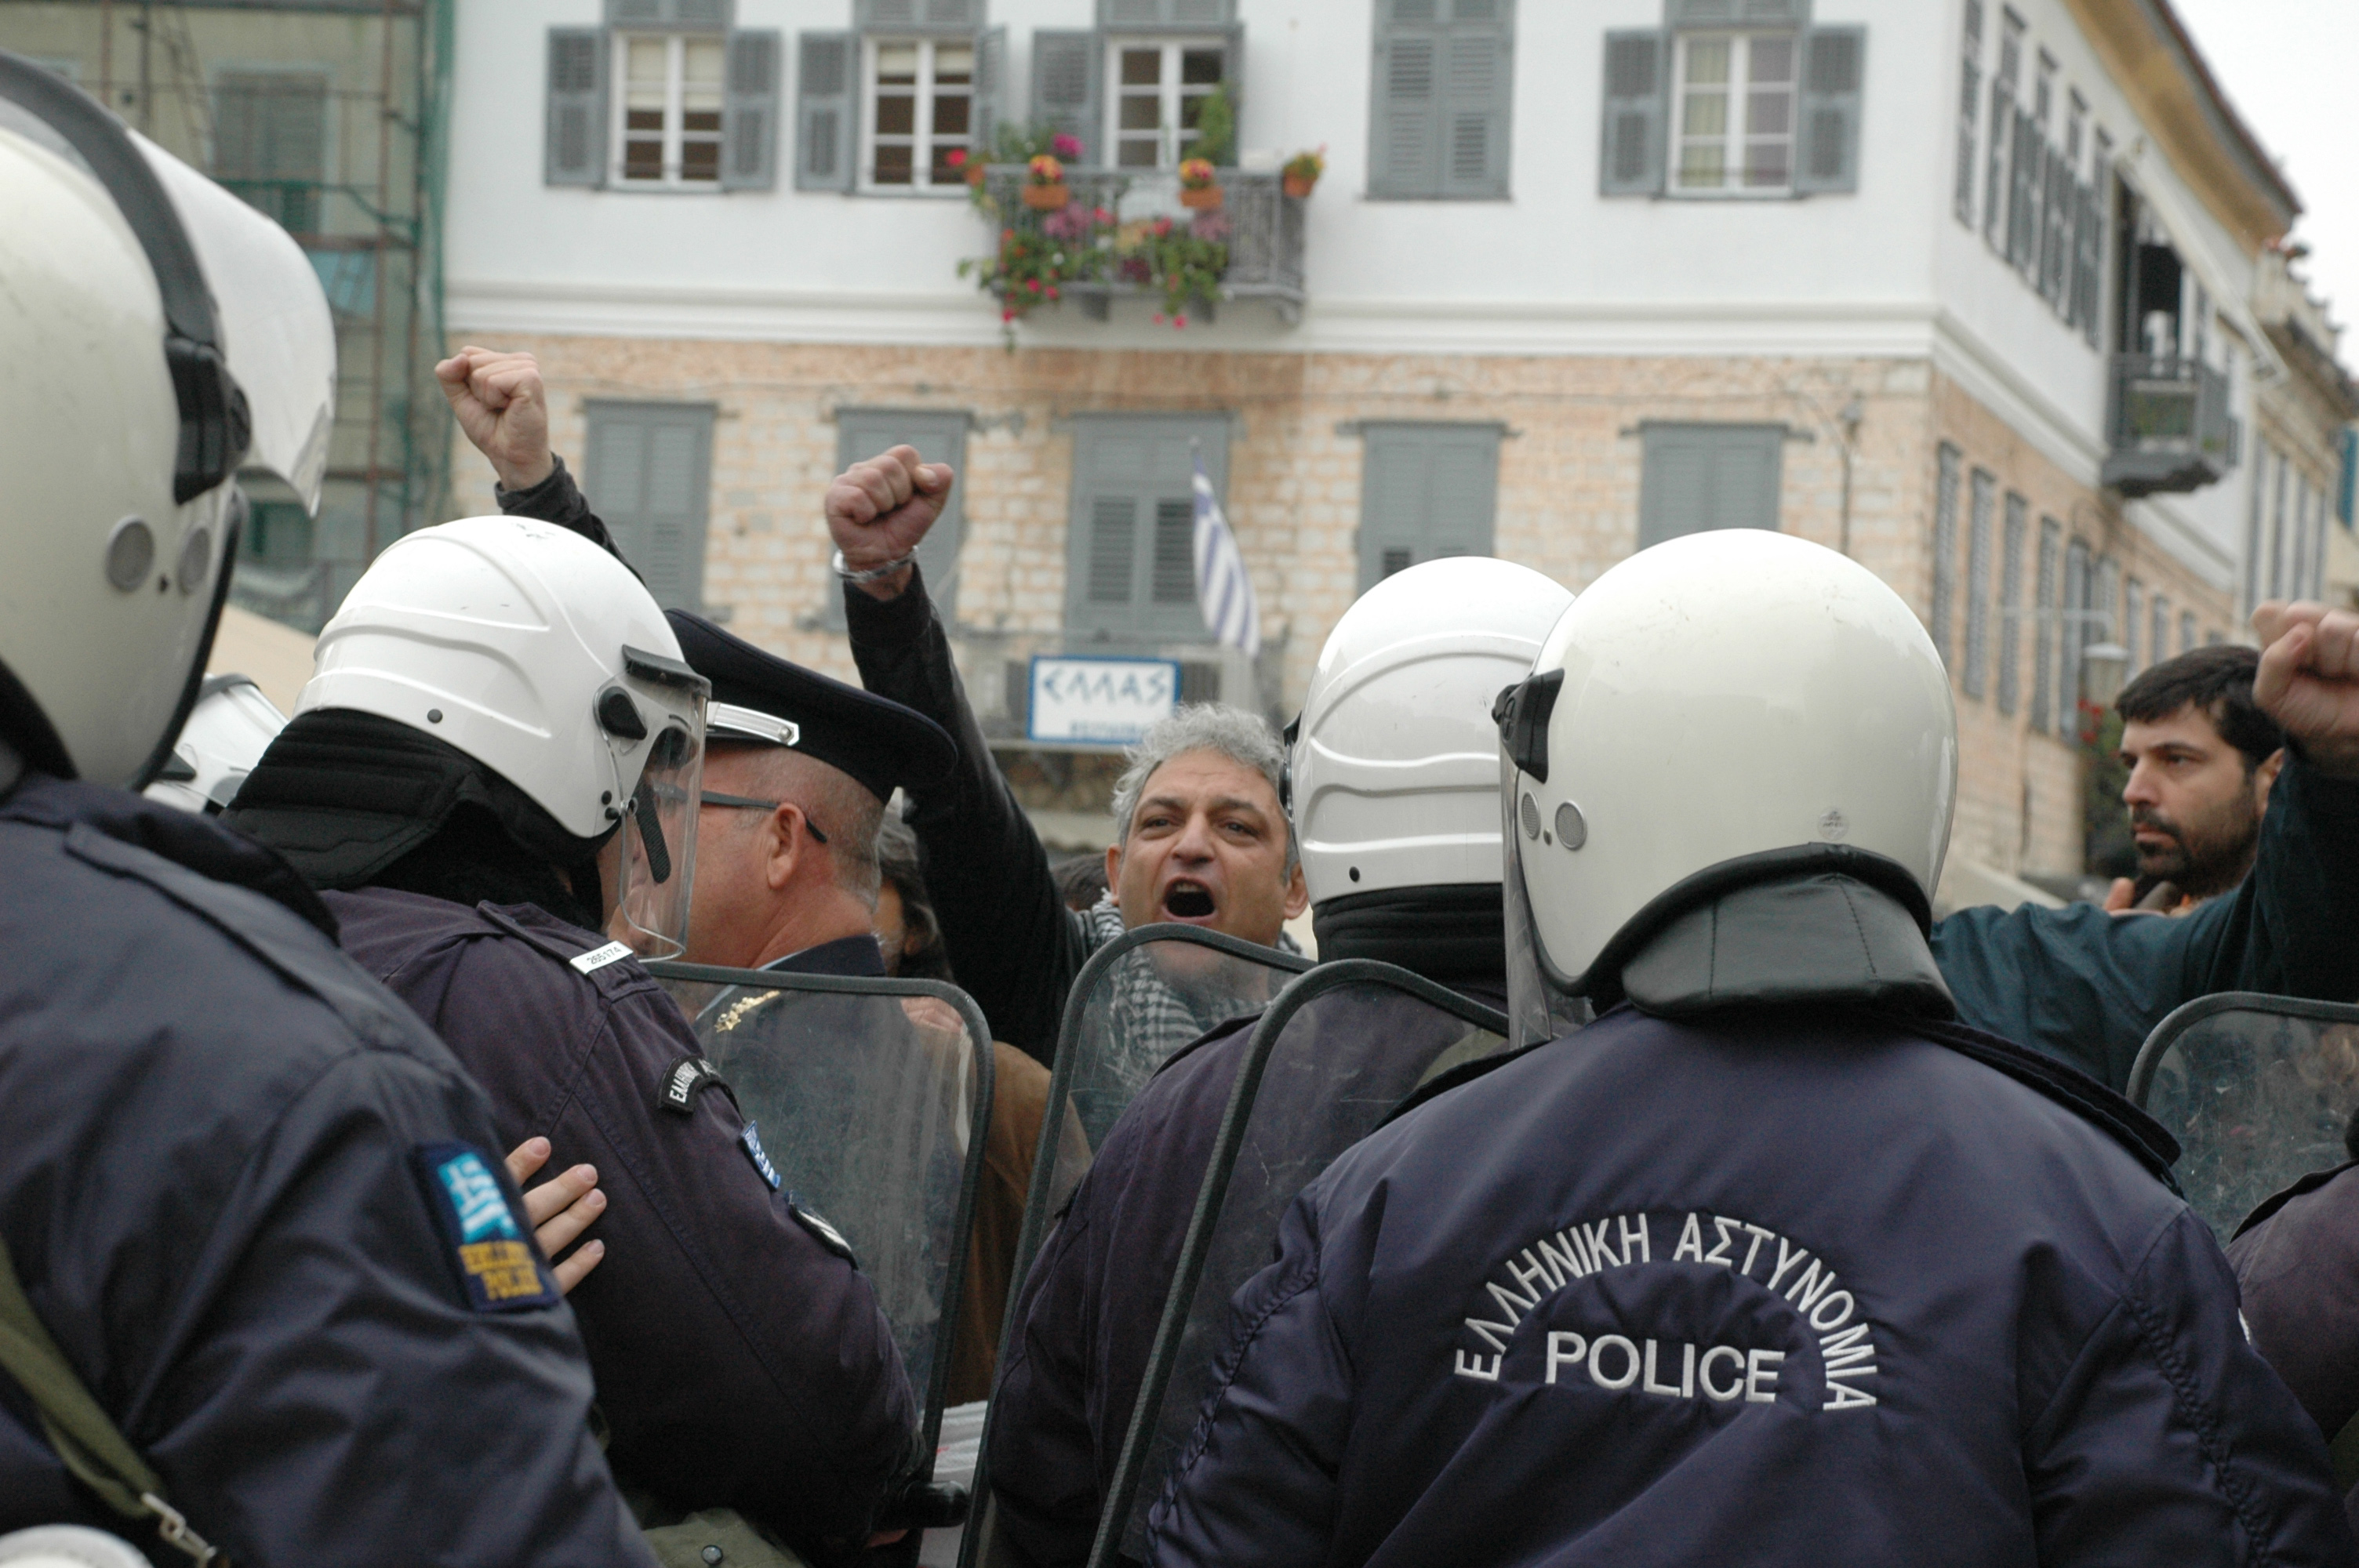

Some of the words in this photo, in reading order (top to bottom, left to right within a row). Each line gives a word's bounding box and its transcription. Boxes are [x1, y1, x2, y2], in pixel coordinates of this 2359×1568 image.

[1454, 1212, 1650, 1381] ΕΛΛΗΝΙΚΗ
[1672, 1212, 1878, 1410] ΑΣΤΥΝΟΜΙΑ
[1544, 1330, 1787, 1403] POLICE
